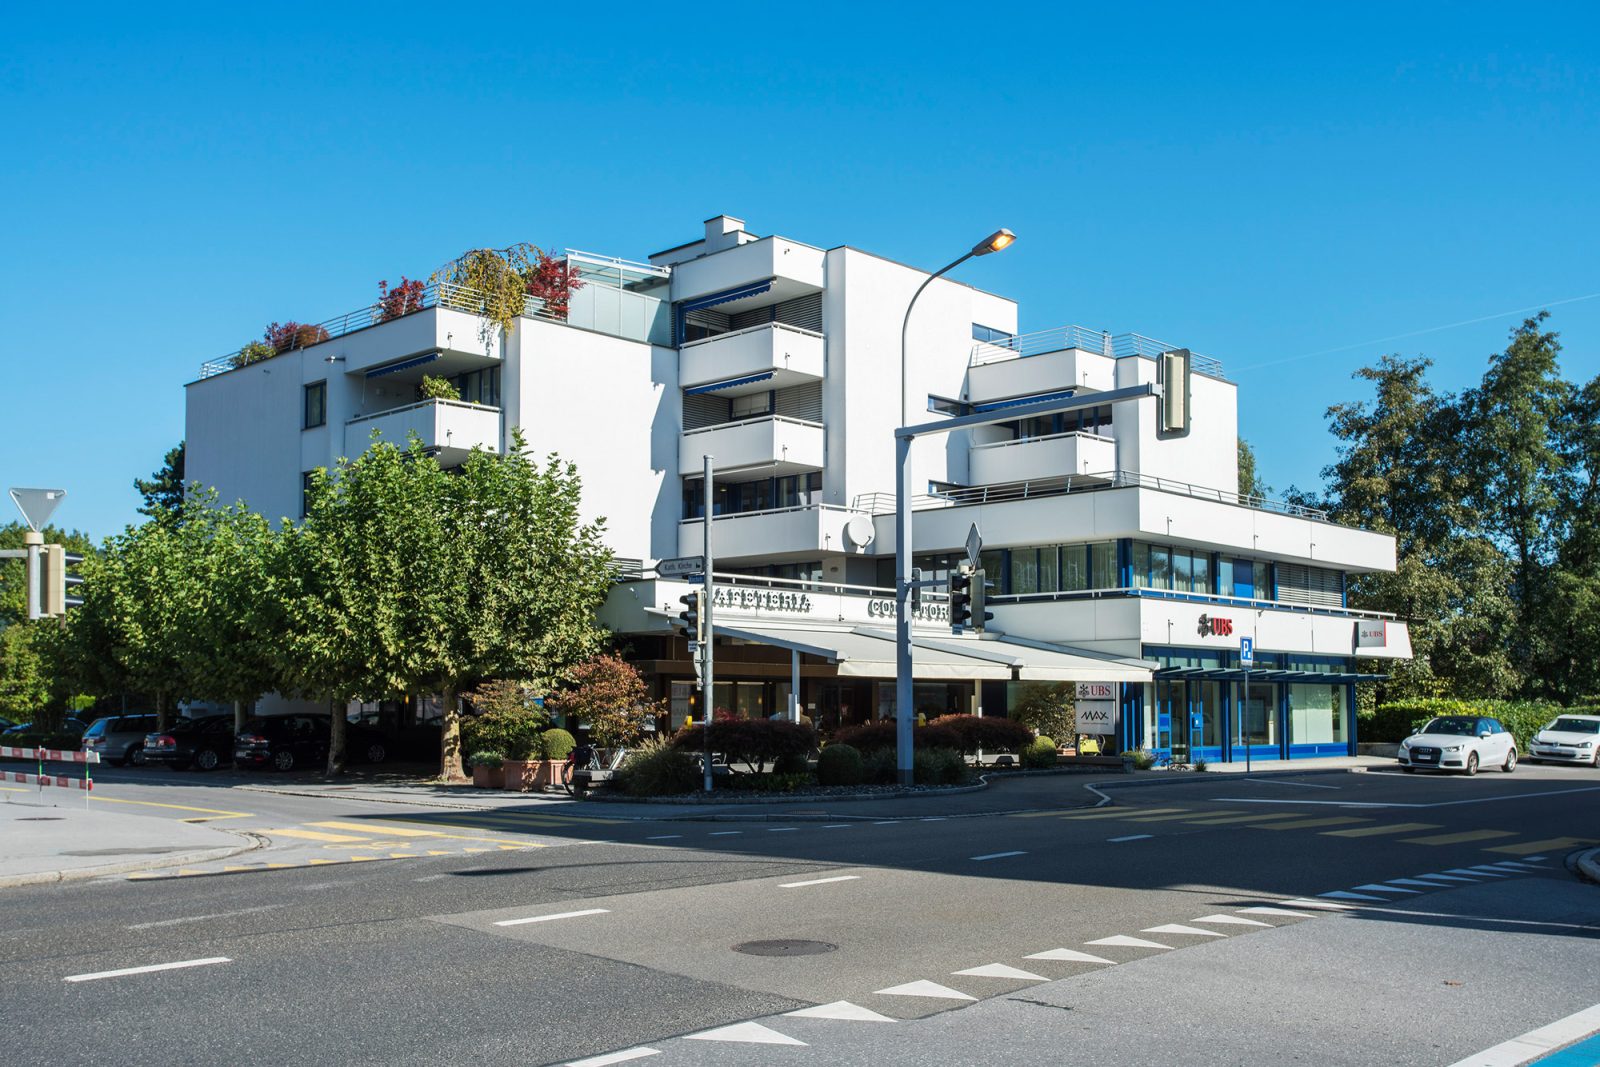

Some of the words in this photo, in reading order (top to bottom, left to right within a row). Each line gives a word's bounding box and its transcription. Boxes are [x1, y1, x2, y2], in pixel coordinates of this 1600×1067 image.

[704, 587, 813, 613] AFETERIA
[1211, 617, 1233, 636] UBS
[1090, 684, 1111, 696] UBS
[1080, 710, 1109, 721] MAX
